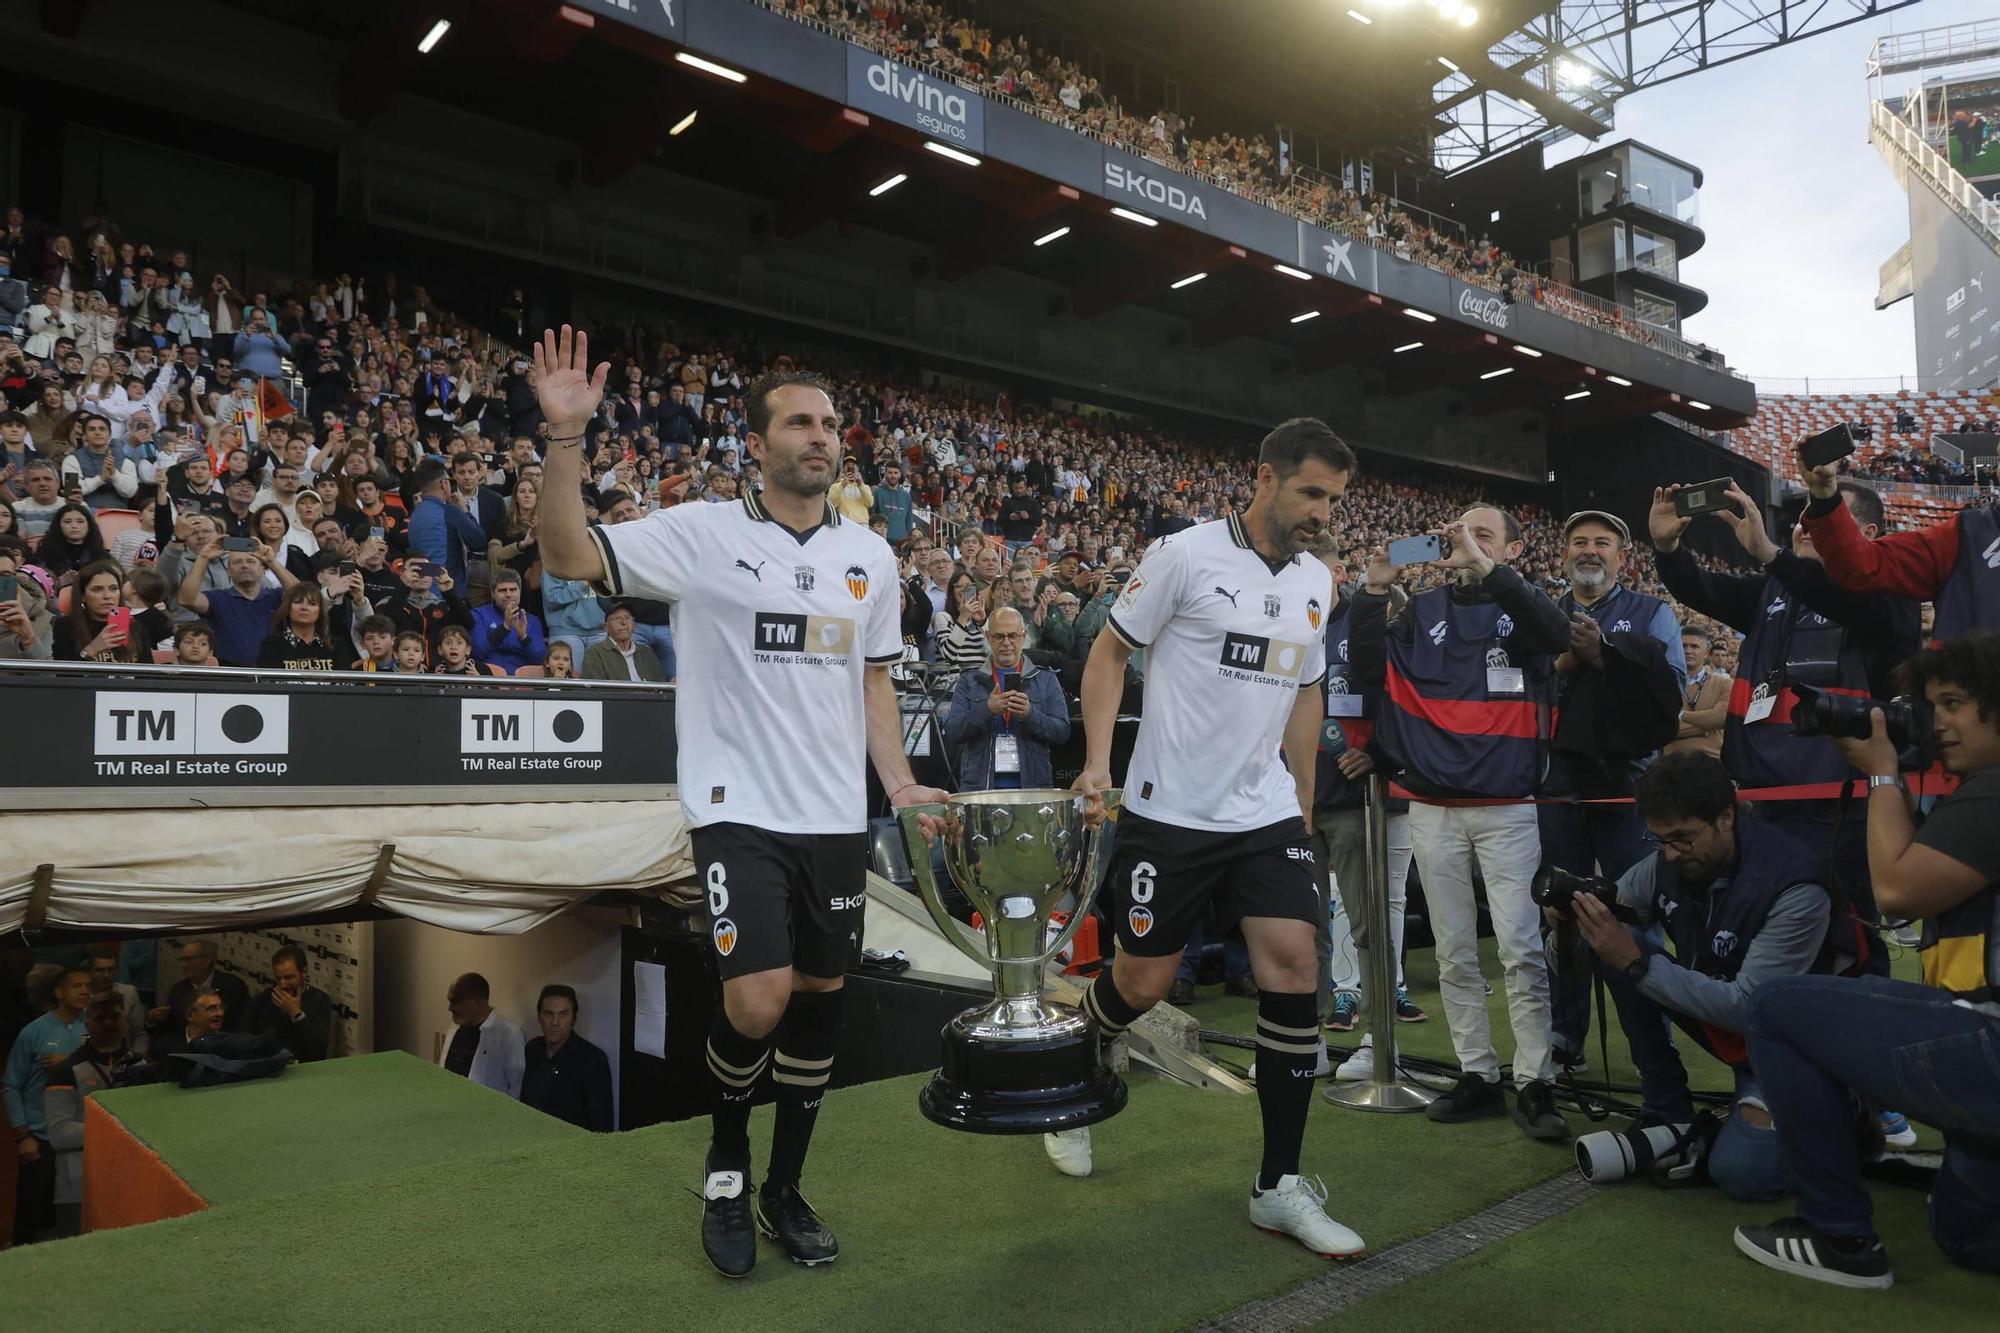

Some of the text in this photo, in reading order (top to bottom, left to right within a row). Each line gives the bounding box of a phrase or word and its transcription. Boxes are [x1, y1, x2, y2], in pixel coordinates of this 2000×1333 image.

[867, 60, 966, 124] divina
[916, 112, 966, 140] seguros
[762, 623, 796, 644] TM
[754, 653, 848, 667] TM Real Estate Group
[1230, 641, 1261, 663] TM
[1217, 667, 1232, 678] TM
[1234, 671, 1253, 682] Real
[1253, 674, 1280, 686] Estate
[109, 709, 176, 741] TM
[471, 714, 520, 741] TM
[94, 760, 288, 776] TM Real Estate Group
[461, 757, 603, 771] TM Real Estate Group
[1055, 769, 1082, 780] SKO
[707, 861, 729, 916] 8
[1131, 861, 1158, 904] 6
[830, 889, 867, 912] SKO
